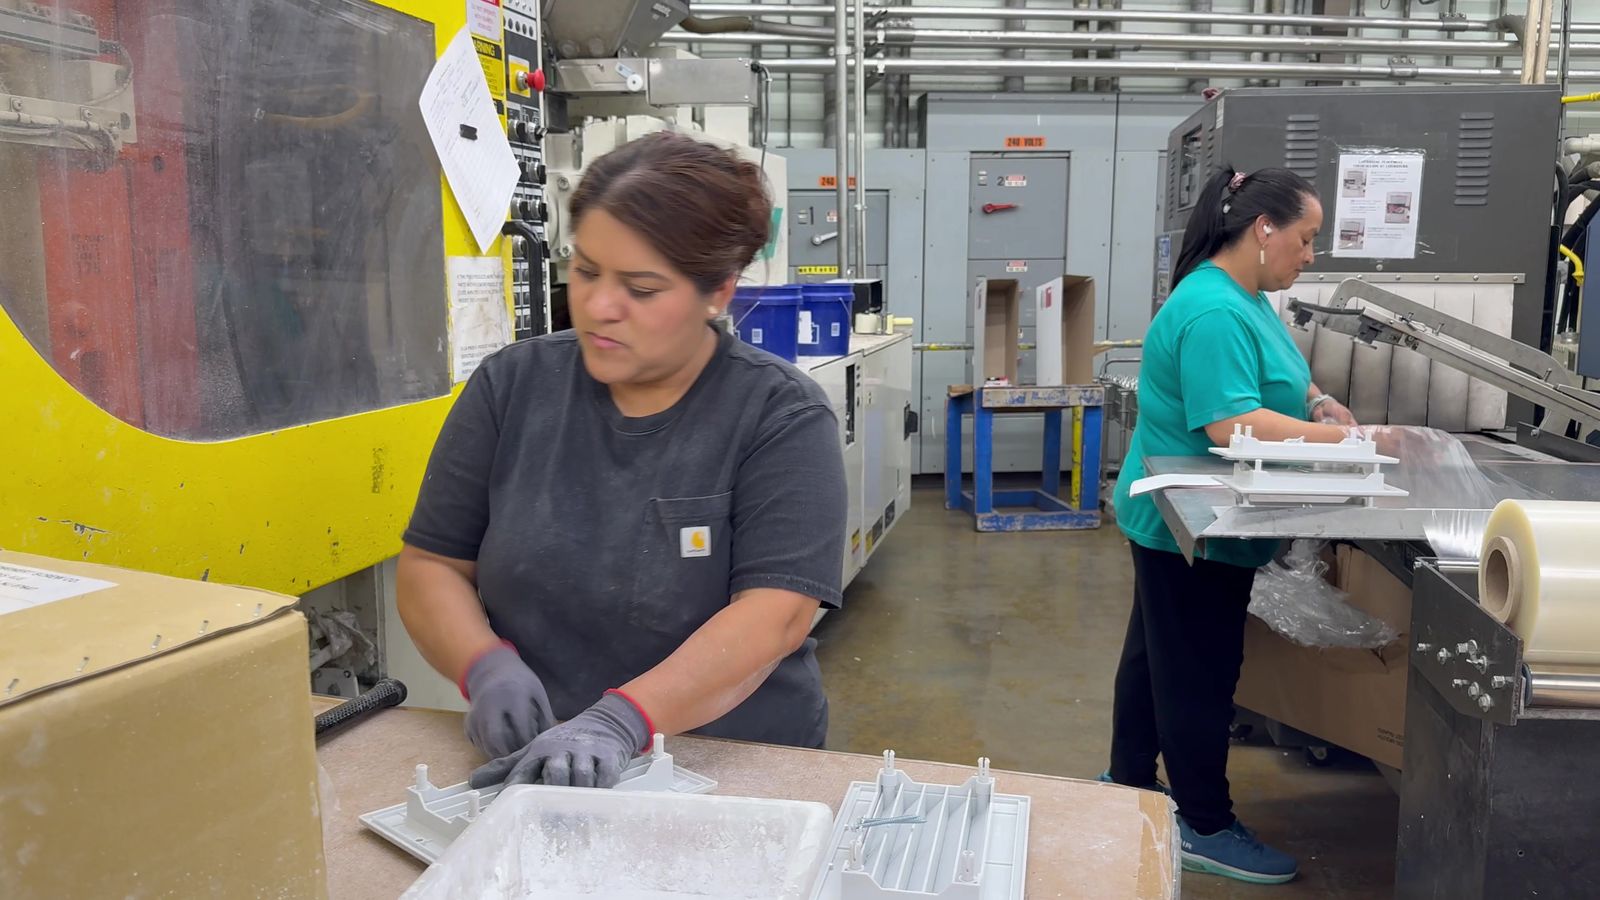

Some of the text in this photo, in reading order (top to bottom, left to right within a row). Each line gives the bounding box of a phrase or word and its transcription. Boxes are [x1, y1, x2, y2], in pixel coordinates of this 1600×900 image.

[472, 39, 496, 57] ARNING
[1007, 137, 1043, 147] 240 VOLTS
[997, 176, 1004, 186] 2
